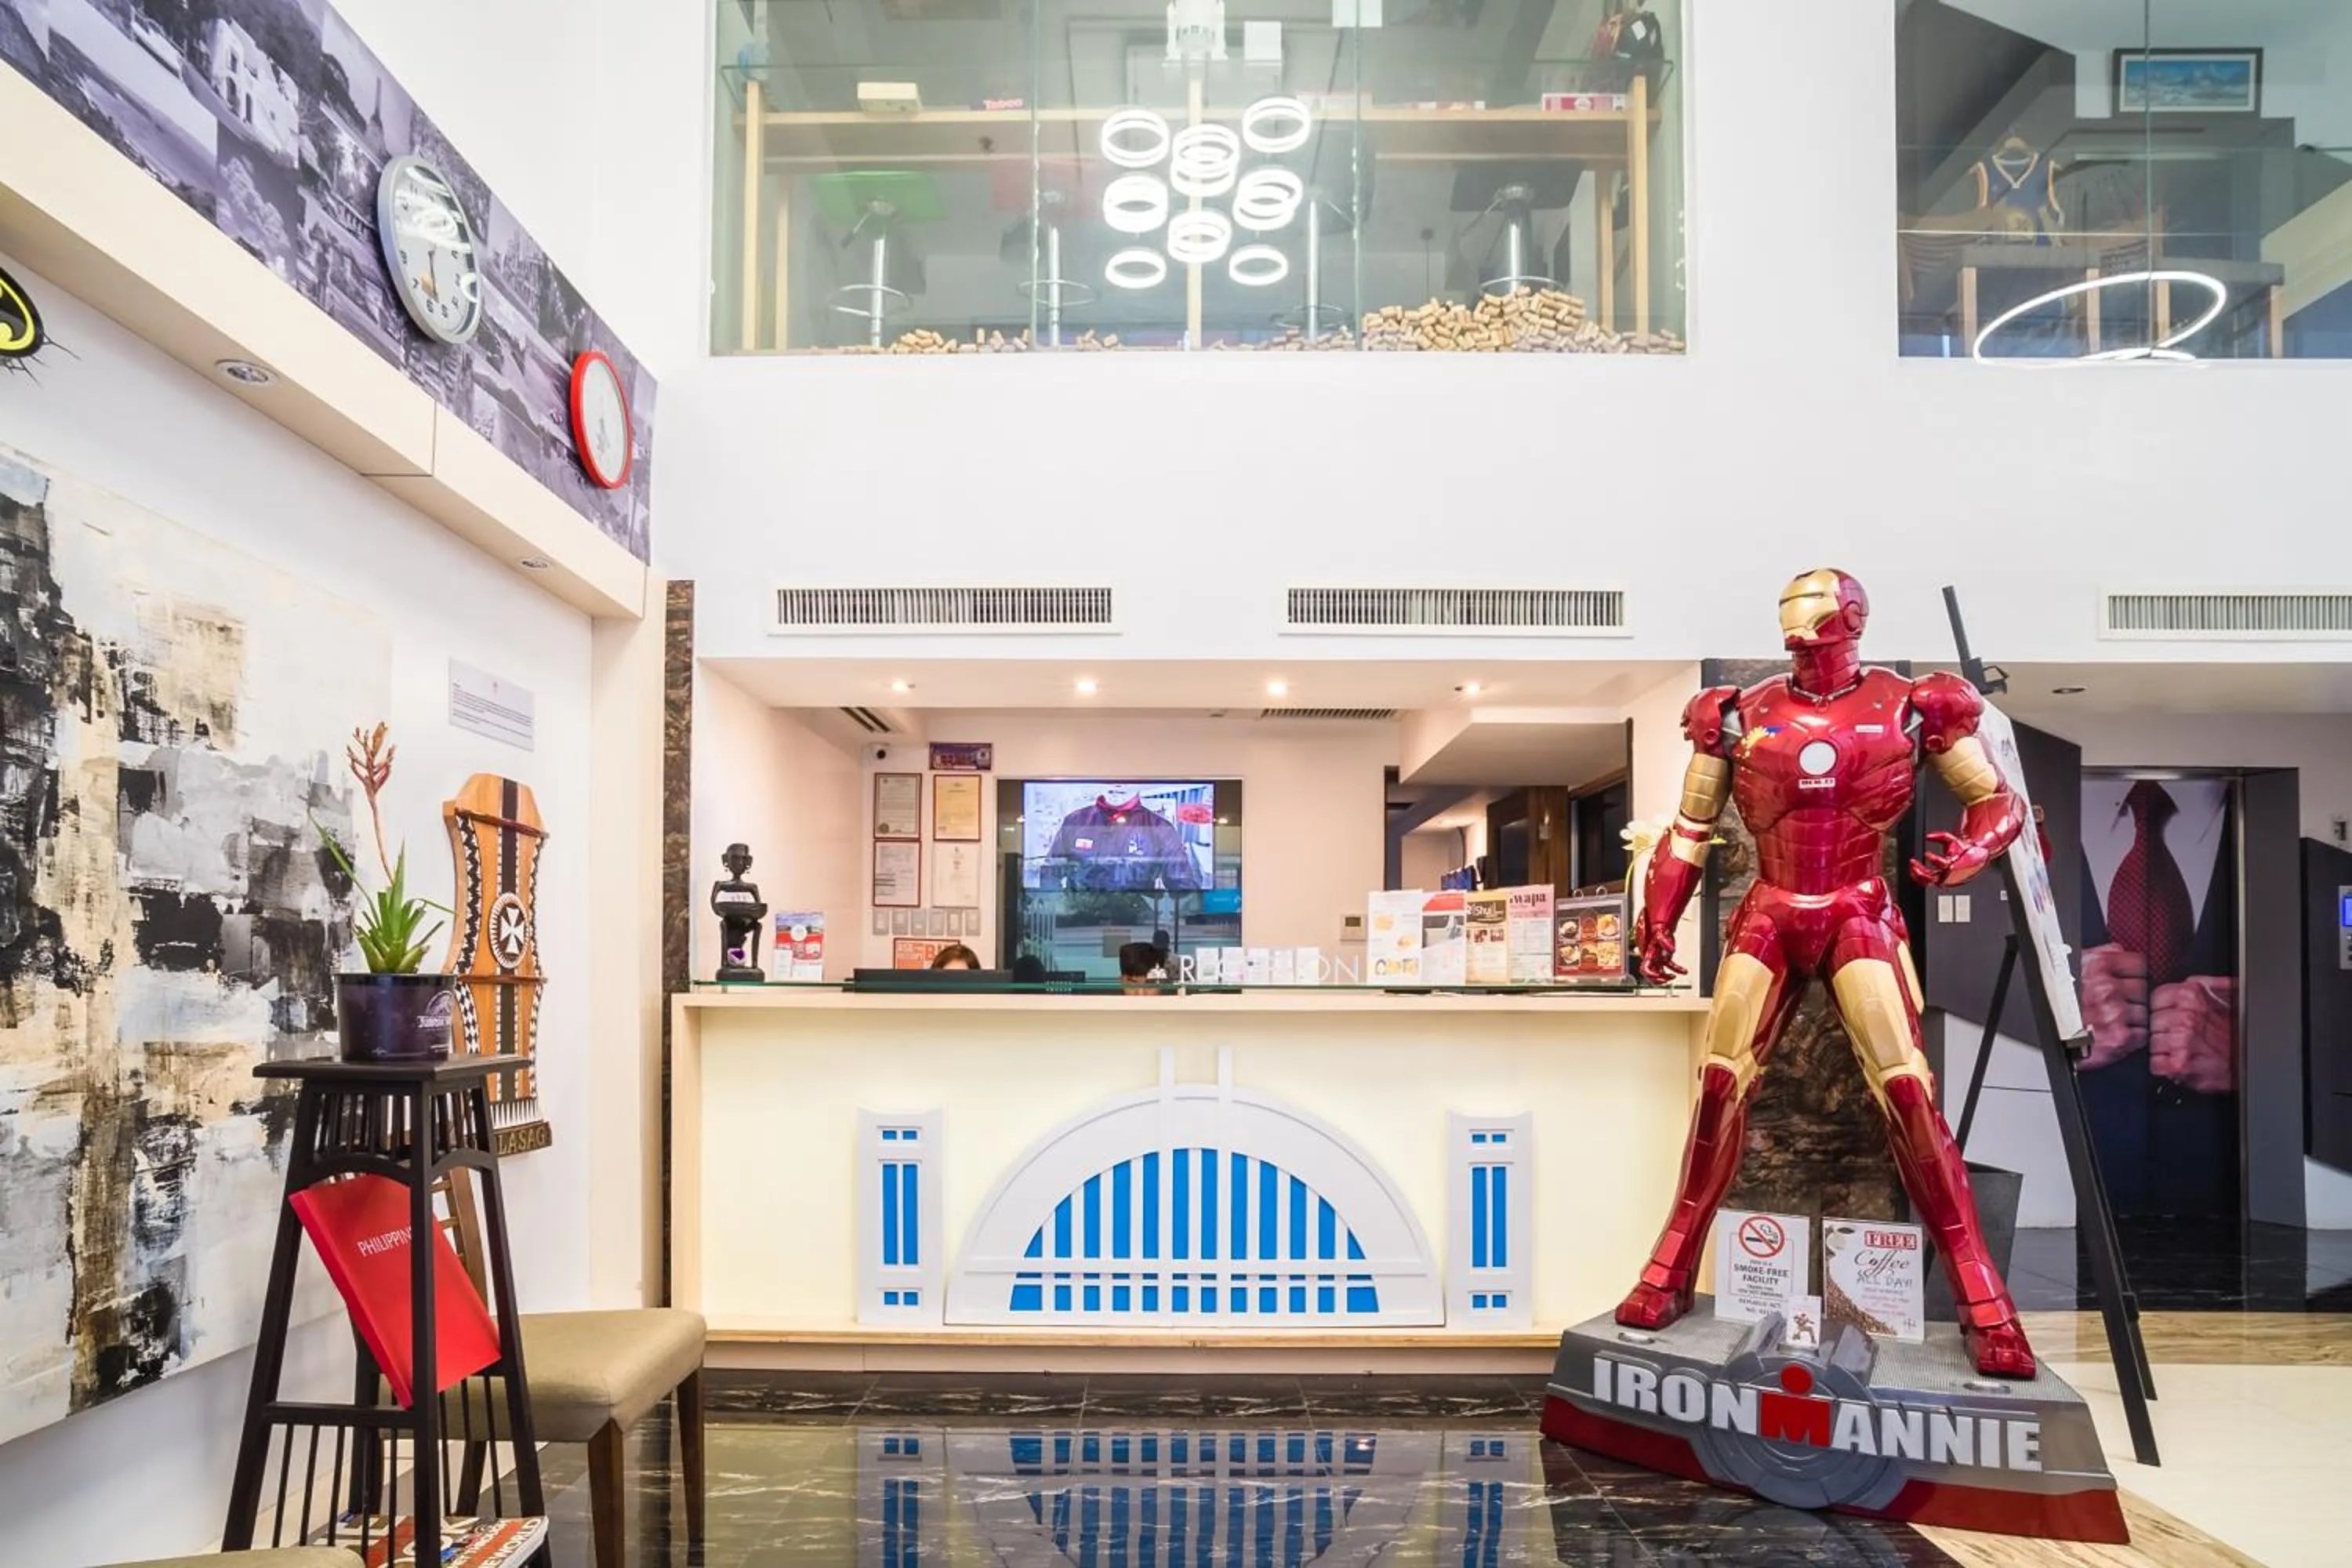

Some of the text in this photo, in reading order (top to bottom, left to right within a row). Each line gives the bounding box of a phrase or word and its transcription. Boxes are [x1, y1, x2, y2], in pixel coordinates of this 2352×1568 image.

[498, 1126, 546, 1156] LASAG
[357, 1225, 412, 1258] PHILIPPIN
[1868, 1232, 1914, 1248] FREE
[1733, 1263, 1790, 1278] SMOKE-FREE
[1853, 1250, 1911, 1277] Coffee
[1743, 1273, 1779, 1286] FACILITY
